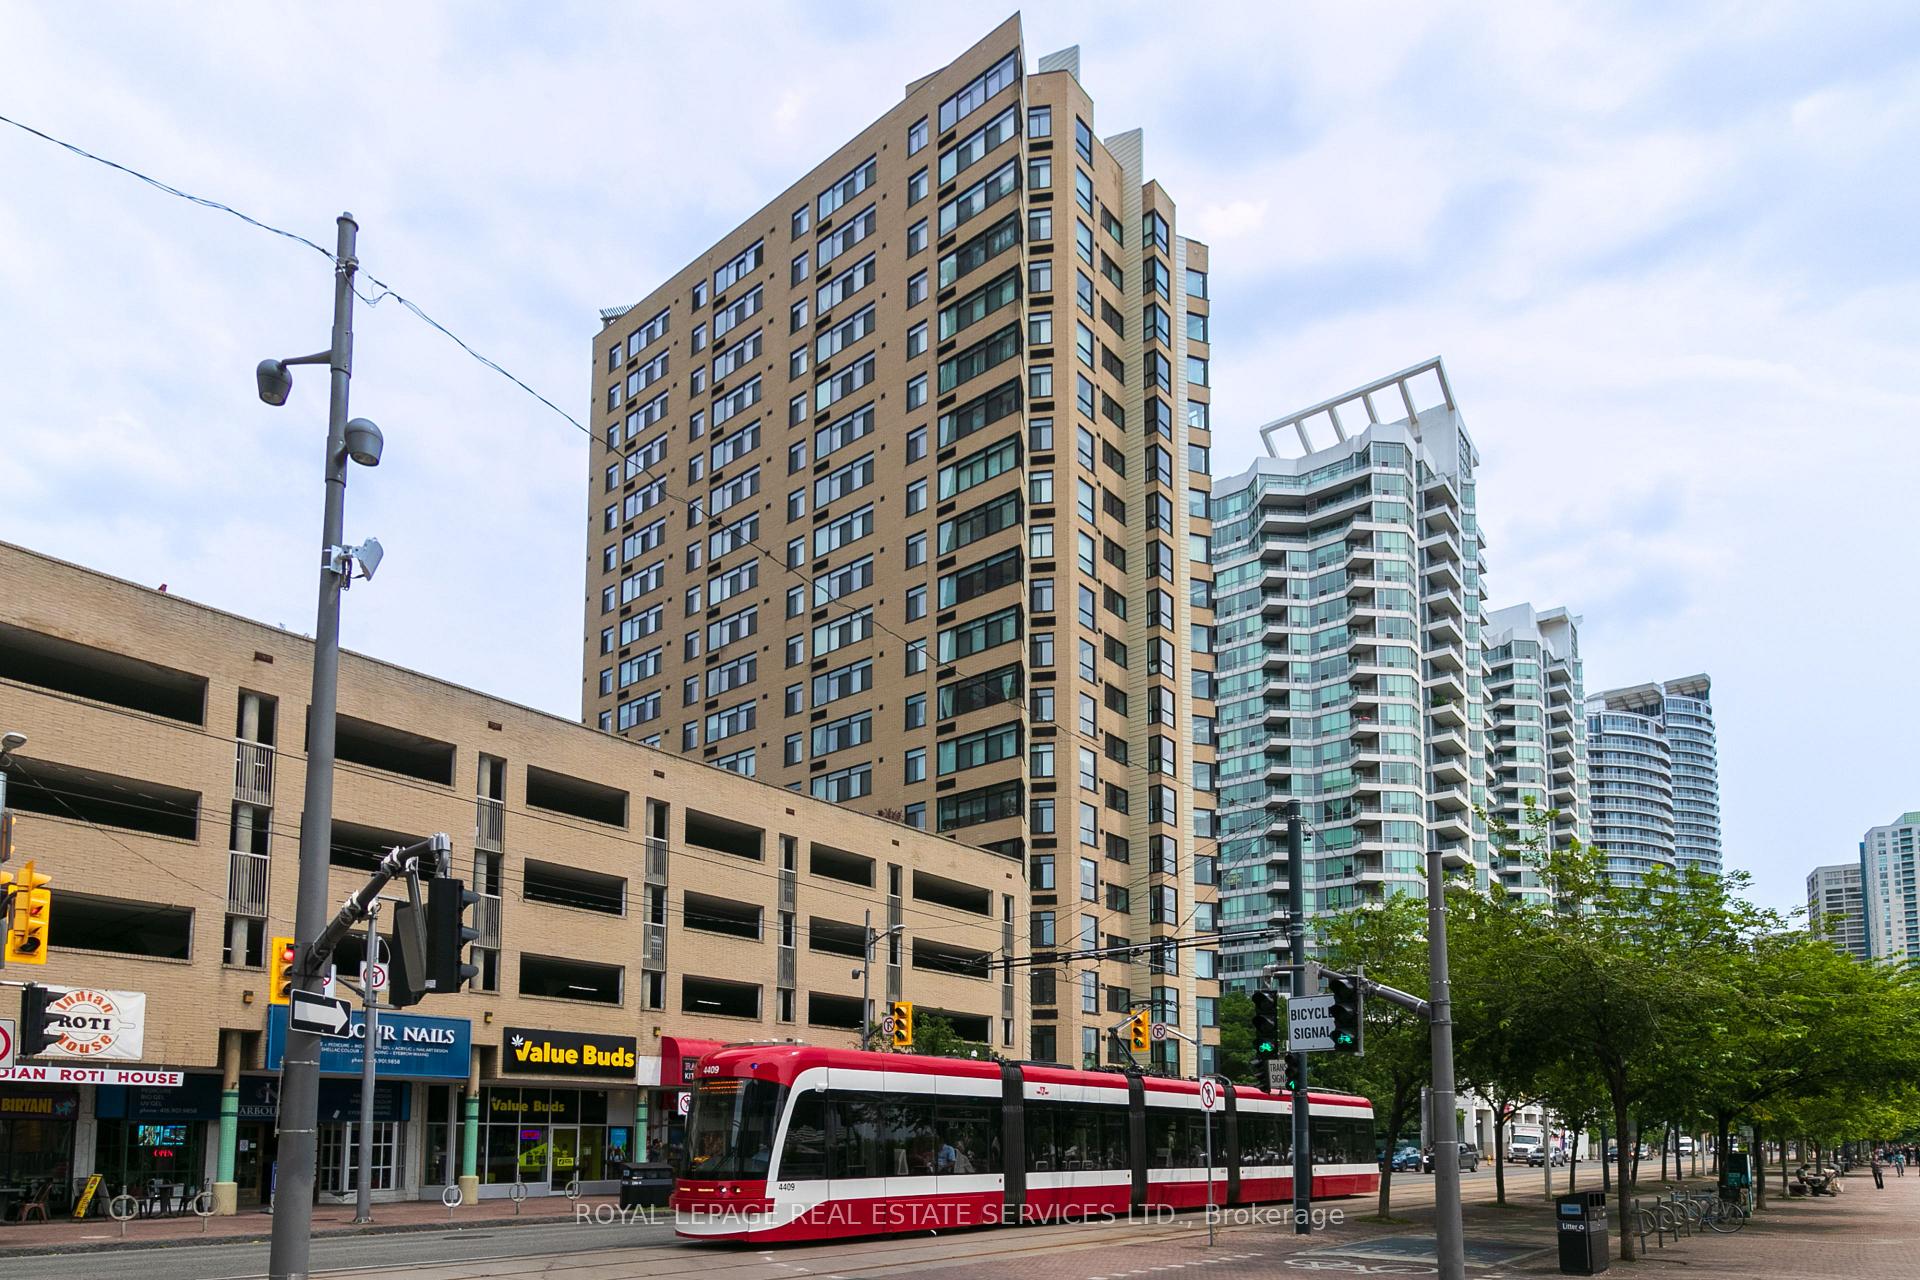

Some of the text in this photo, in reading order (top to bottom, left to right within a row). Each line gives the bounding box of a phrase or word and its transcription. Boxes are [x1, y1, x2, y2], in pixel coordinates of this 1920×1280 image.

[55, 991, 113, 1013] Indian
[58, 1015, 110, 1031] ROTI
[403, 1026, 455, 1045] NAILS
[1294, 1026, 1331, 1040] SIGNAL
[515, 1041, 635, 1068] Value Buds
[703, 1065, 720, 1074] 4409
[60, 1070, 105, 1083] ROTI
[117, 1072, 179, 1085] HOUSE
[1, 1097, 53, 1114] BIRYANI
[491, 1099, 566, 1113] Value Buds
[778, 1182, 796, 1192] 4409
[1562, 1222, 1578, 1231] Litter
